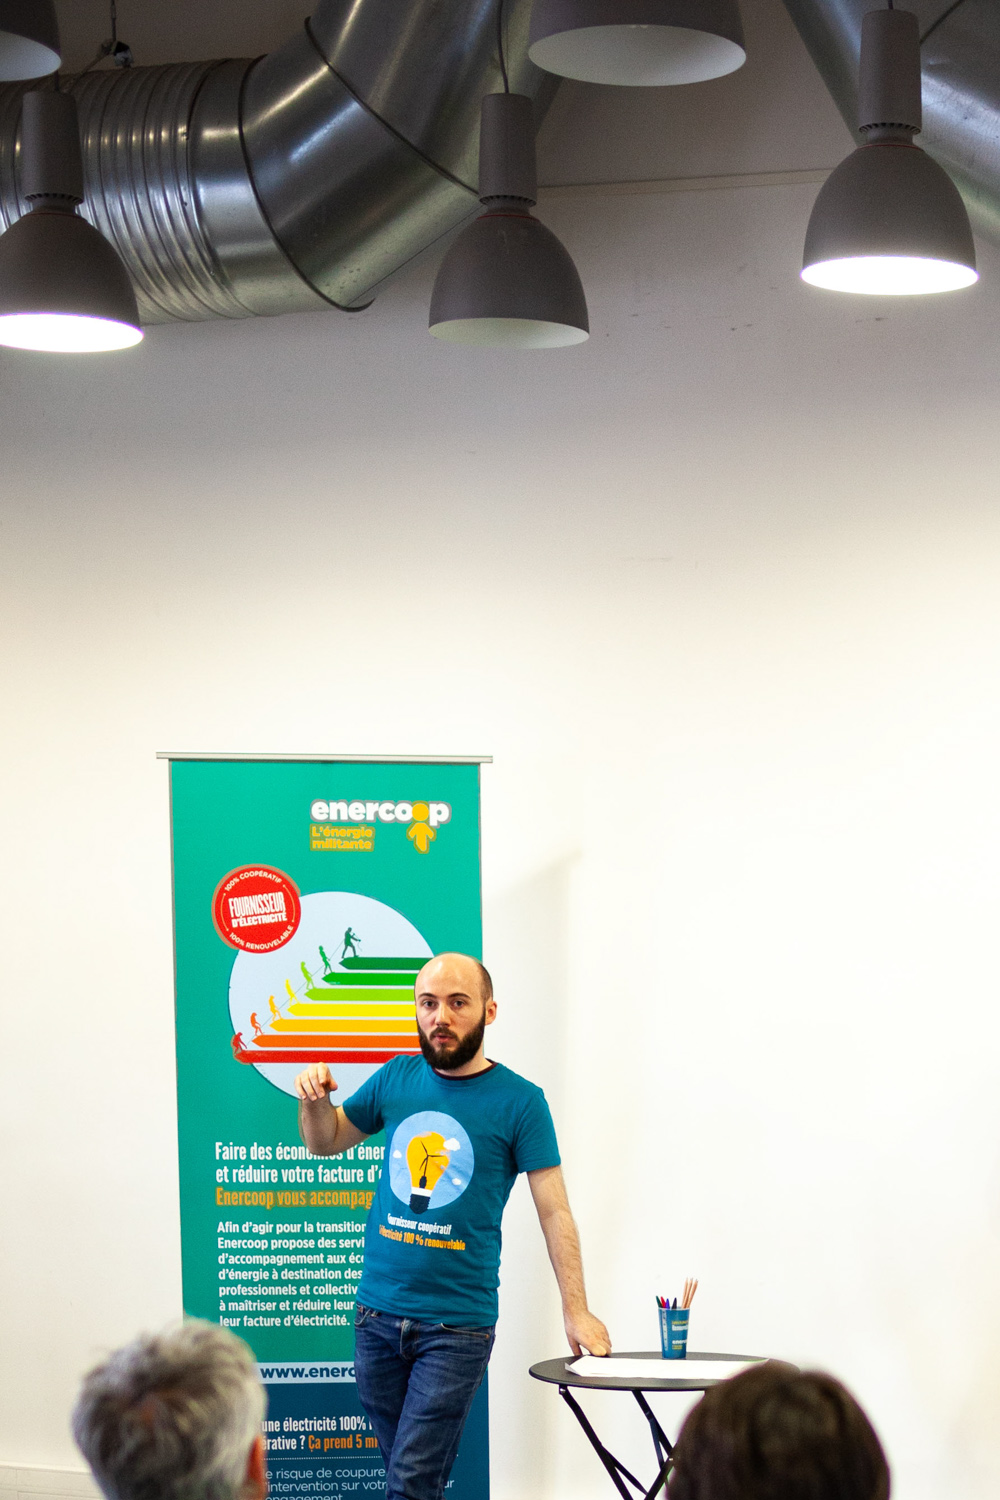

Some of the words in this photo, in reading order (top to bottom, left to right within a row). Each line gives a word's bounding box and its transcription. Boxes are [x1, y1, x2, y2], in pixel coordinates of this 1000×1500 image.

[312, 826, 373, 839] L'énergie
[312, 838, 372, 849] militante
[225, 877, 240, 891] 100%
[240, 870, 282, 883] COOPÉRATIF
[228, 891, 286, 918] FOURNISSEUR
[229, 932, 245, 946] 100%
[246, 925, 294, 949] RENOUVELABLE
[215, 1142, 247, 1160] Faire
[250, 1142, 273, 1160] des
[216, 1166, 229, 1183] et
[232, 1164, 278, 1183] réduire
[281, 1166, 314, 1183] votre
[317, 1164, 364, 1183] facture
[216, 1187, 274, 1210] Enercoop
[277, 1191, 306, 1205] vous
[310, 1191, 375, 1209] accompag
[217, 1221, 240, 1233] Afin
[242, 1221, 274, 1235] d'agir
[276, 1223, 302, 1235] pour
[304, 1221, 314, 1233] la
[316, 1221, 366, 1233] transition
[217, 1237, 268, 1250] Enercoop
[271, 1239, 315, 1250] propose
[317, 1237, 337, 1248] des
[218, 1253, 325, 1266] d'accompagnement
[326, 1255, 346, 1264] aux
[218, 1268, 270, 1282] d'énergie
[272, 1268, 279, 1280] à
[281, 1268, 342, 1280] destination
[344, 1268, 363, 1279] des
[219, 1284, 298, 1297] professionnels
[299, 1284, 310, 1295] et
[219, 1299, 226, 1311] à
[228, 1299, 277, 1311] maîtriser
[279, 1300, 290, 1311] et
[292, 1299, 331, 1311] réduire
[333, 1299, 355, 1310] leur
[219, 1315, 241, 1327] leur
[243, 1315, 281, 1327] facture
[284, 1315, 350, 1326] d'électricité.
[283, 1416, 337, 1432] électricité
[339, 1416, 366, 1431] 100%
[299, 1435, 306, 1449] ?
[308, 1434, 321, 1452] Ça
[323, 1434, 353, 1452] prend
[355, 1434, 362, 1448] 5
[276, 1468, 313, 1480] risque
[316, 1467, 332, 1479] de
[335, 1468, 386, 1479] coupure
[341, 1482, 359, 1491] sur
